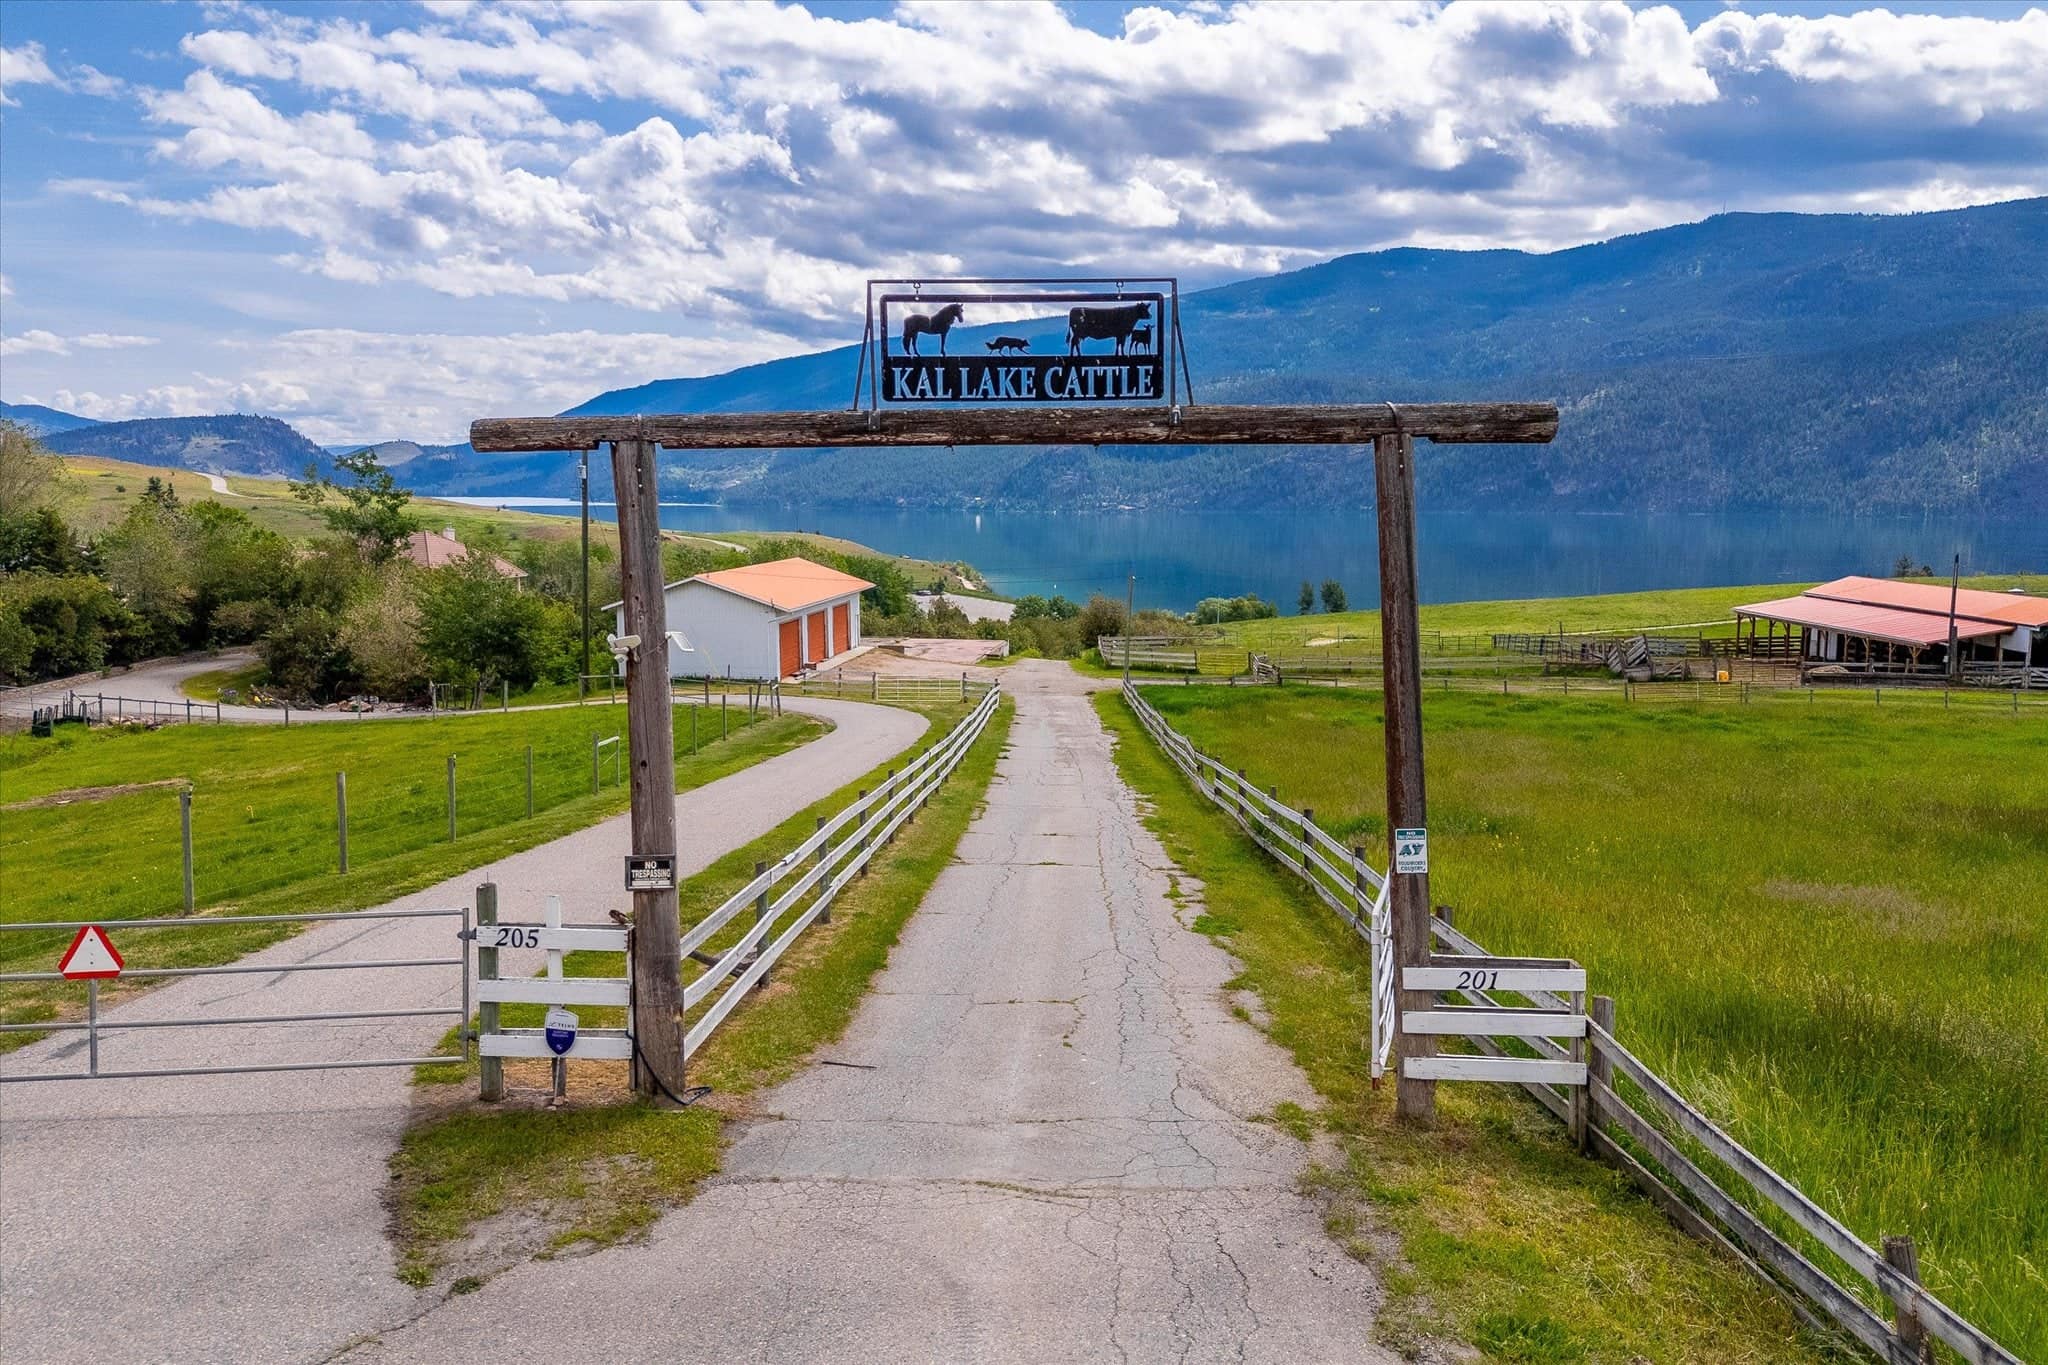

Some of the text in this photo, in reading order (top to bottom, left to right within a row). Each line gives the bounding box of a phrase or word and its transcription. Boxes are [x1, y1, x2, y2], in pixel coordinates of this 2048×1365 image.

[892, 365, 1155, 399] KAL LAKE CATTLE
[631, 869, 671, 878] TRESPASSING
[645, 860, 657, 869] NO
[494, 927, 540, 949] 205
[1456, 966, 1499, 990] 201
